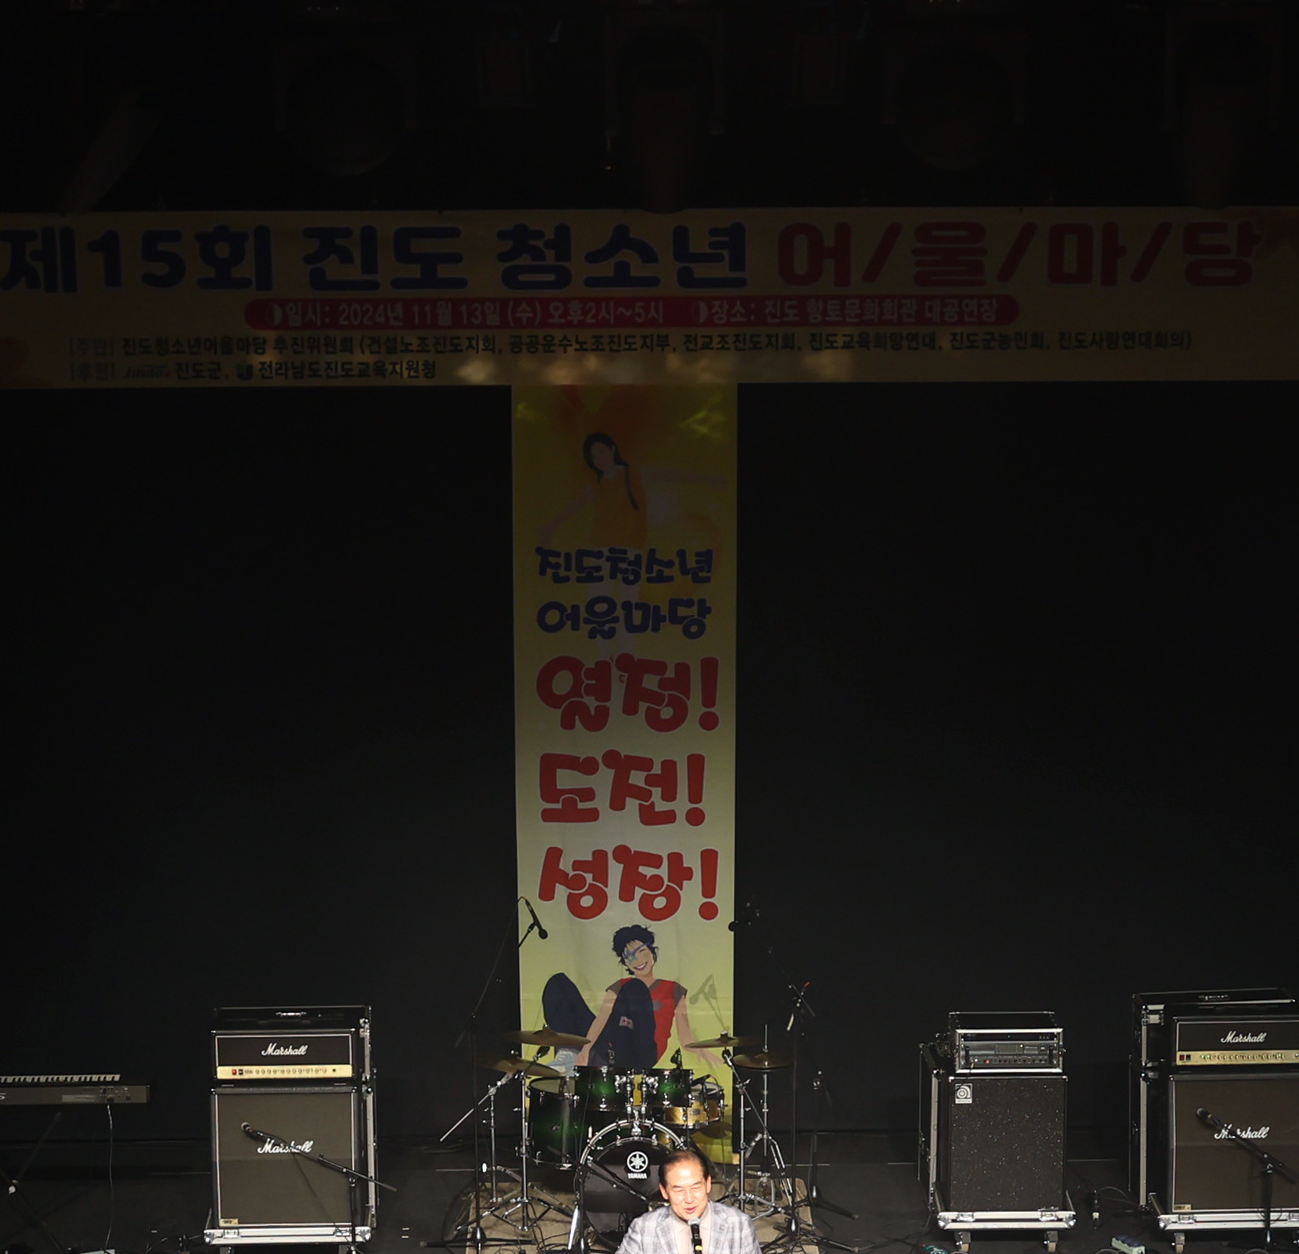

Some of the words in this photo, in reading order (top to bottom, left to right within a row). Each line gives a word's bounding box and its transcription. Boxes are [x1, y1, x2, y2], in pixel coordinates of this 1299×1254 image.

[302, 223, 469, 291] 진도
[496, 221, 749, 291] 청소년
[777, 220, 1263, 288] 어/울/마/당
[286, 302, 331, 328] 일시:
[337, 302, 404, 327] 2024년
[411, 300, 454, 327] 11월
[459, 300, 501, 326] 13일
[507, 299, 542, 327] (수)
[547, 299, 665, 326] 오후2시~5시
[764, 299, 800, 324] 진도
[806, 297, 918, 323] 향토문화회관
[924, 297, 999, 323] 대공연장
[273, 335, 355, 355] 추진위원회
[258, 359, 437, 380] 전라남도진도교육지원청
[536, 547, 714, 586] 진도청소년
[536, 597, 712, 640] 어울마당
[536, 653, 721, 733] 열정!
[540, 749, 707, 827] 도전!
[538, 845, 719, 921] 성장!
[261, 1043, 308, 1056] Marshall
[1220, 1031, 1268, 1043] Marshall
